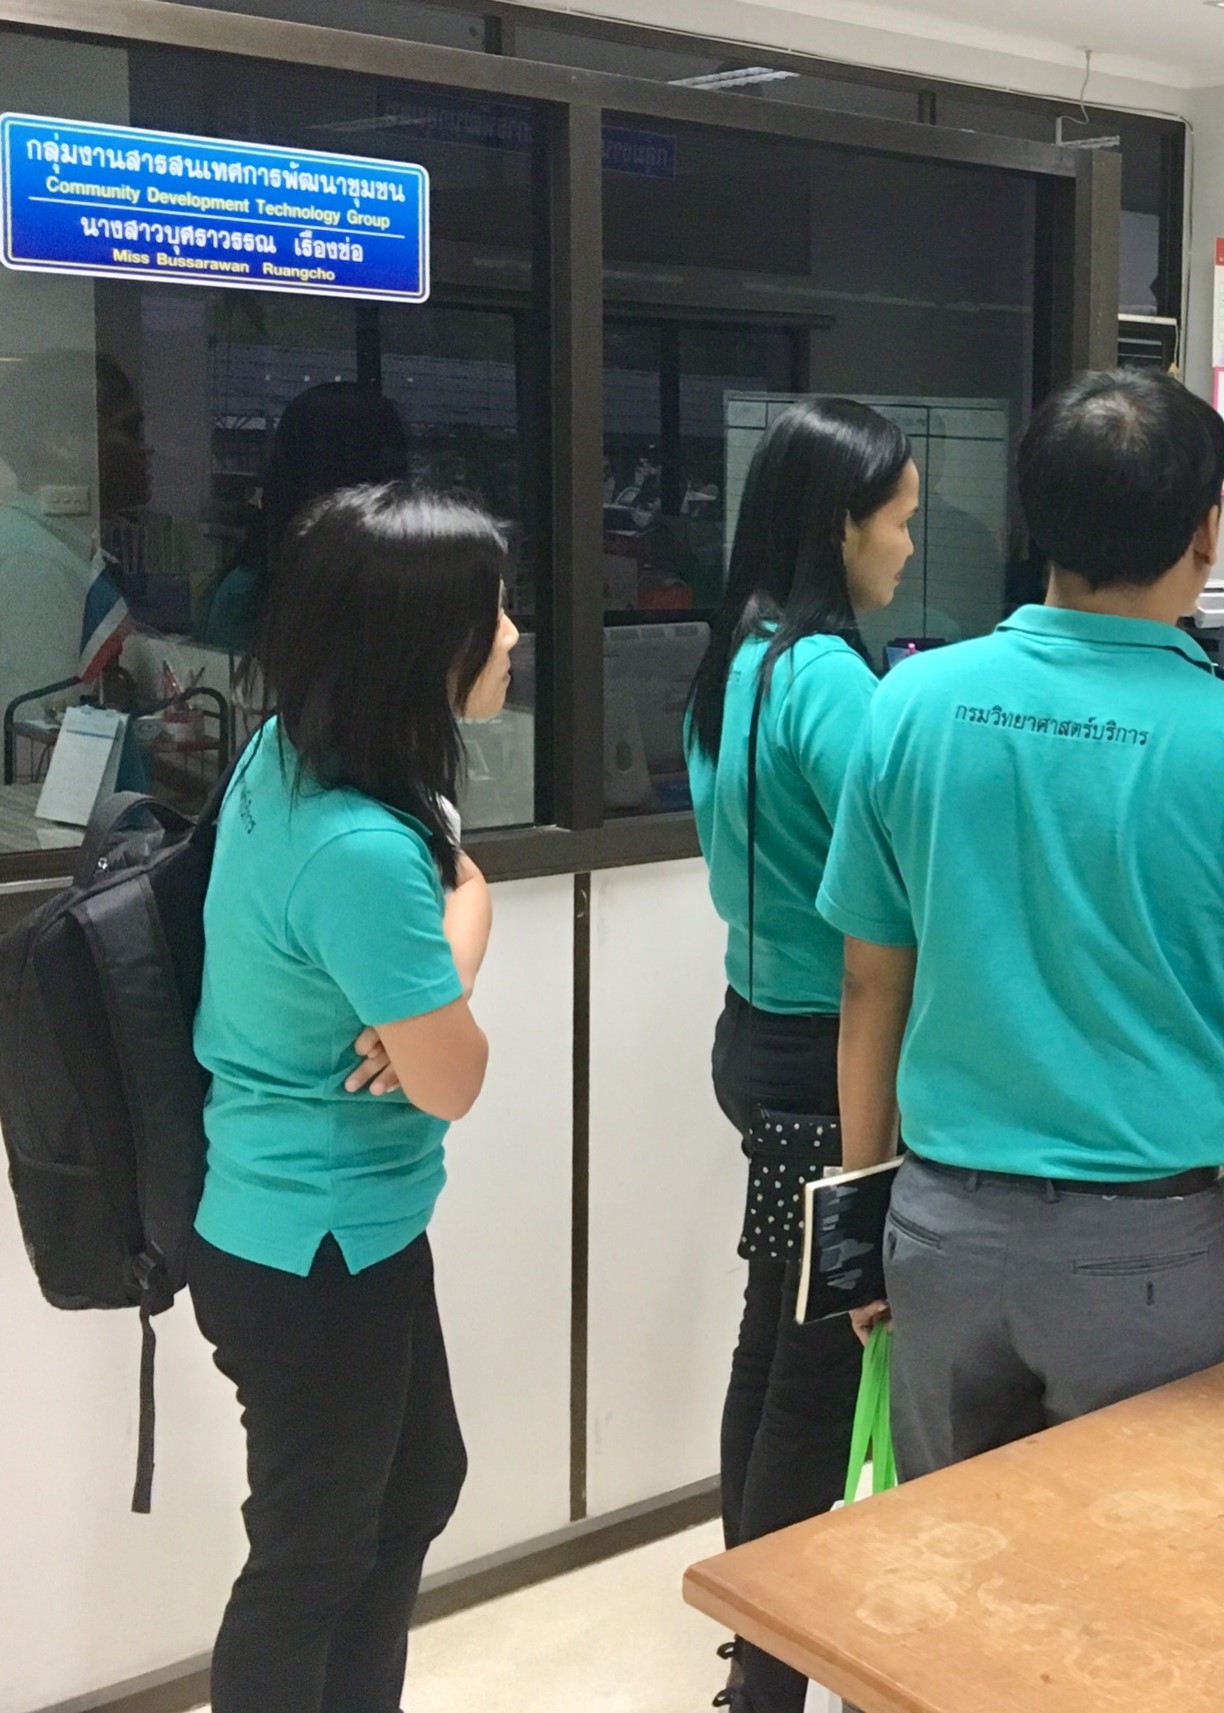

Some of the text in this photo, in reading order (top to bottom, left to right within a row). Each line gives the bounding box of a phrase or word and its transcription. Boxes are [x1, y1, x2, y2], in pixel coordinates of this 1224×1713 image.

[46, 176, 391, 230] Community Development Technology Group
[112, 249, 335, 280] Miss Bussarawan Ruangcho
[955, 704, 1149, 746] กรมวิทยาศาสตร์บริการ
